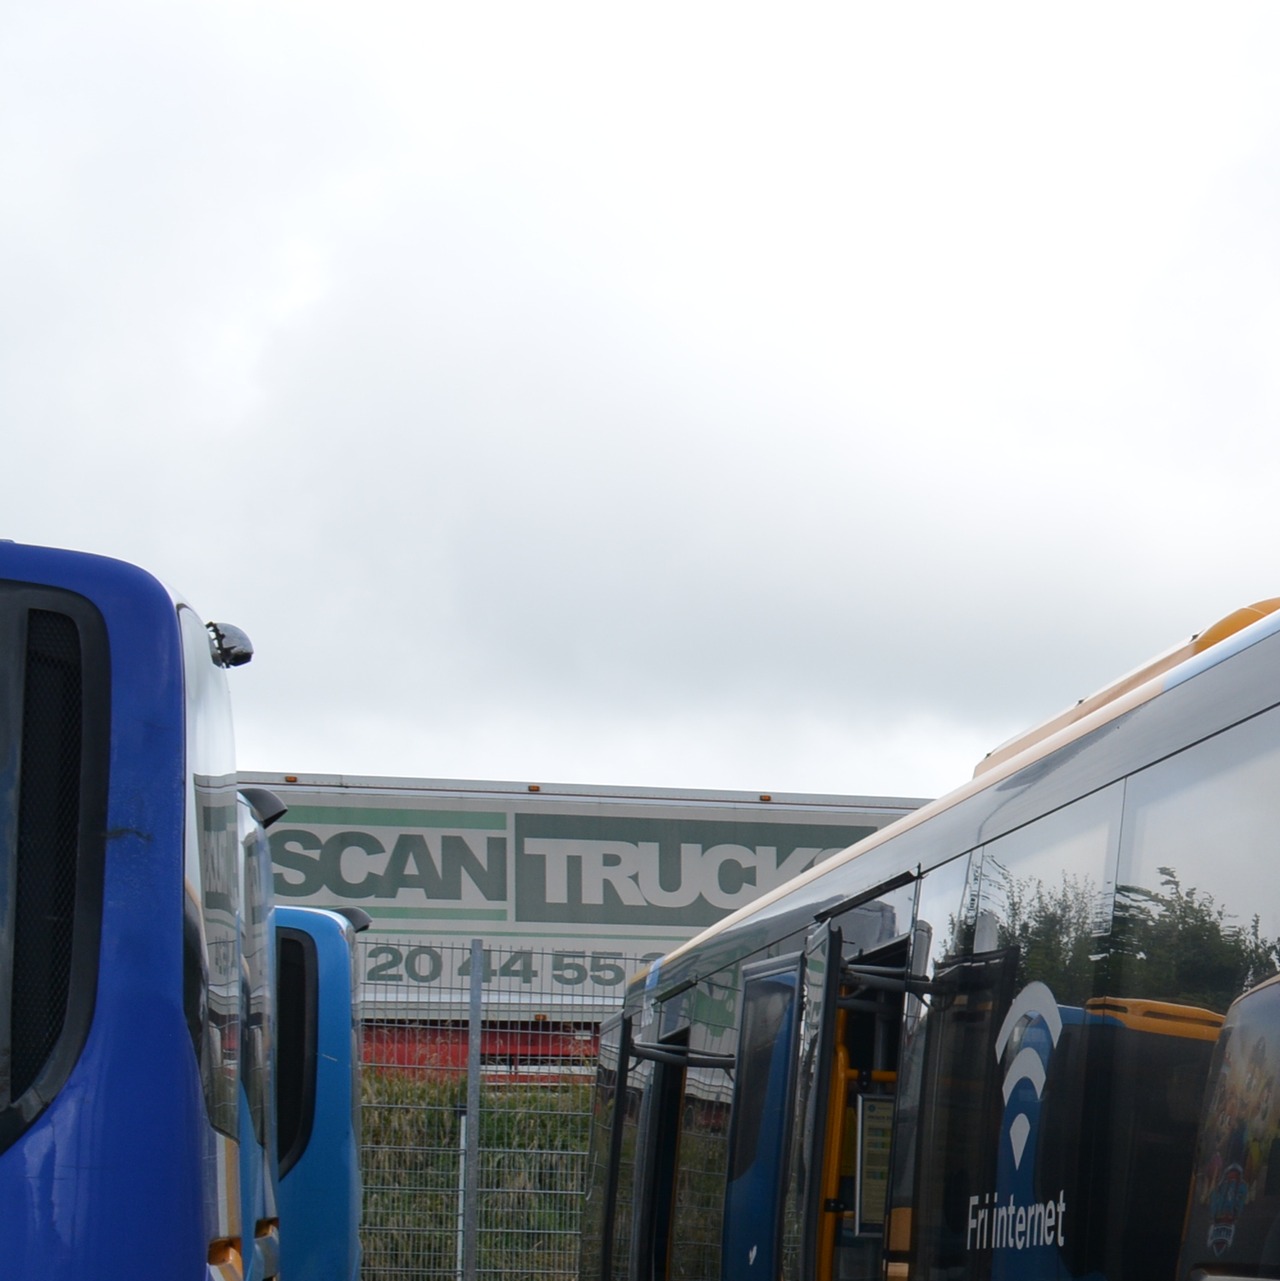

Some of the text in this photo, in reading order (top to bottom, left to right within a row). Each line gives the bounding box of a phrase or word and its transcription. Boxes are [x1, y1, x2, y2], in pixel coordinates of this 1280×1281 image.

[268, 829, 846, 910] SCAN TRUCK
[366, 945, 626, 987] 20 44 55
[966, 1189, 1066, 1251] Fri internet
